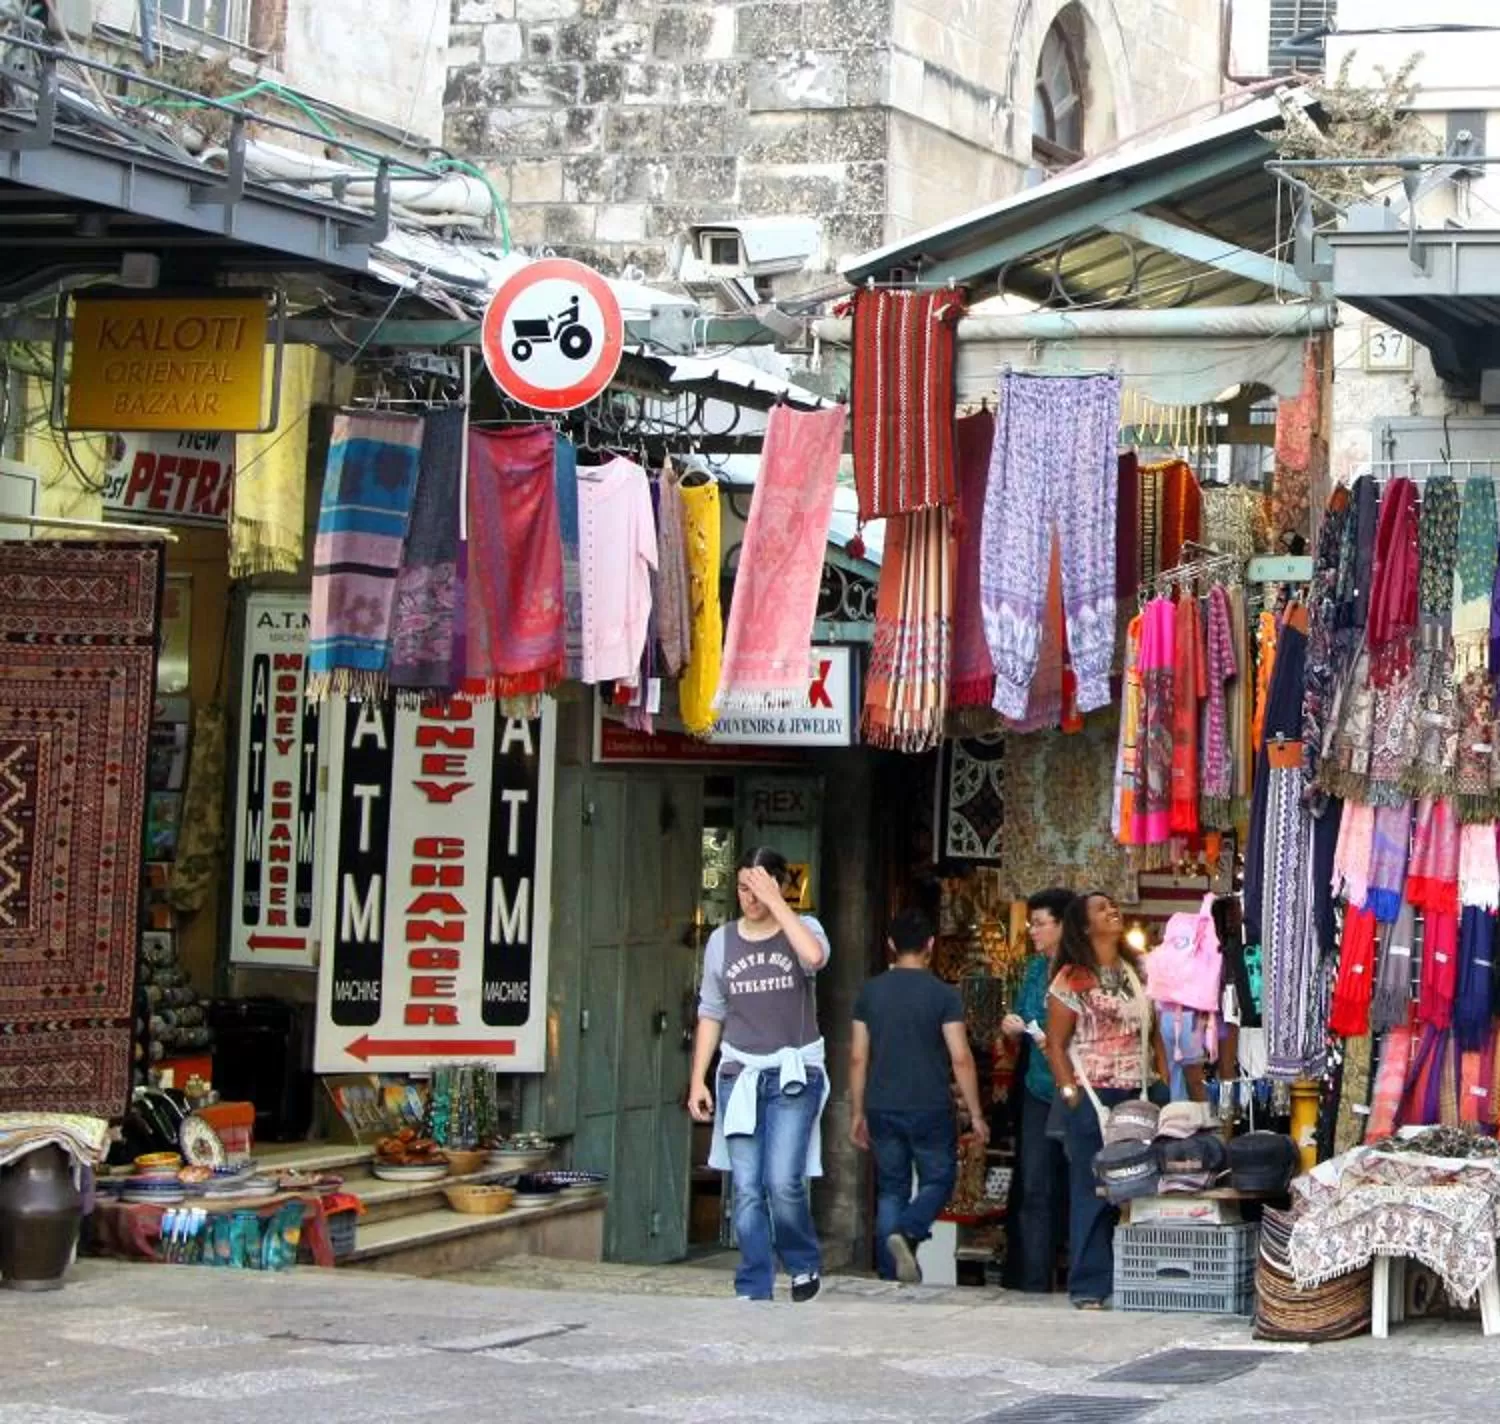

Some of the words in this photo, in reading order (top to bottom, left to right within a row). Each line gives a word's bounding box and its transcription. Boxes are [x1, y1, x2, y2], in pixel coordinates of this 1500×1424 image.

[98, 316, 249, 351] KALOTI
[1371, 333, 1403, 358] 37
[105, 359, 235, 383] ORIENTAL
[113, 392, 221, 415] BAZAAR
[102, 472, 129, 499] est
[273, 653, 303, 756] MONEY
[713, 718, 776, 735] SOUVENIRS
[777, 718, 786, 735] &
[789, 718, 843, 735] JEWELRY
[412, 699, 476, 804] ONEY
[753, 788, 804, 812] REX
[267, 780, 293, 927] CHANGER
[405, 837, 468, 1026] CHANGER
[727, 952, 765, 979] SOUTH
[335, 980, 381, 1001] MACHINE
[484, 981, 528, 1003] MACHINE
[730, 975, 795, 995] ATHLETICS
